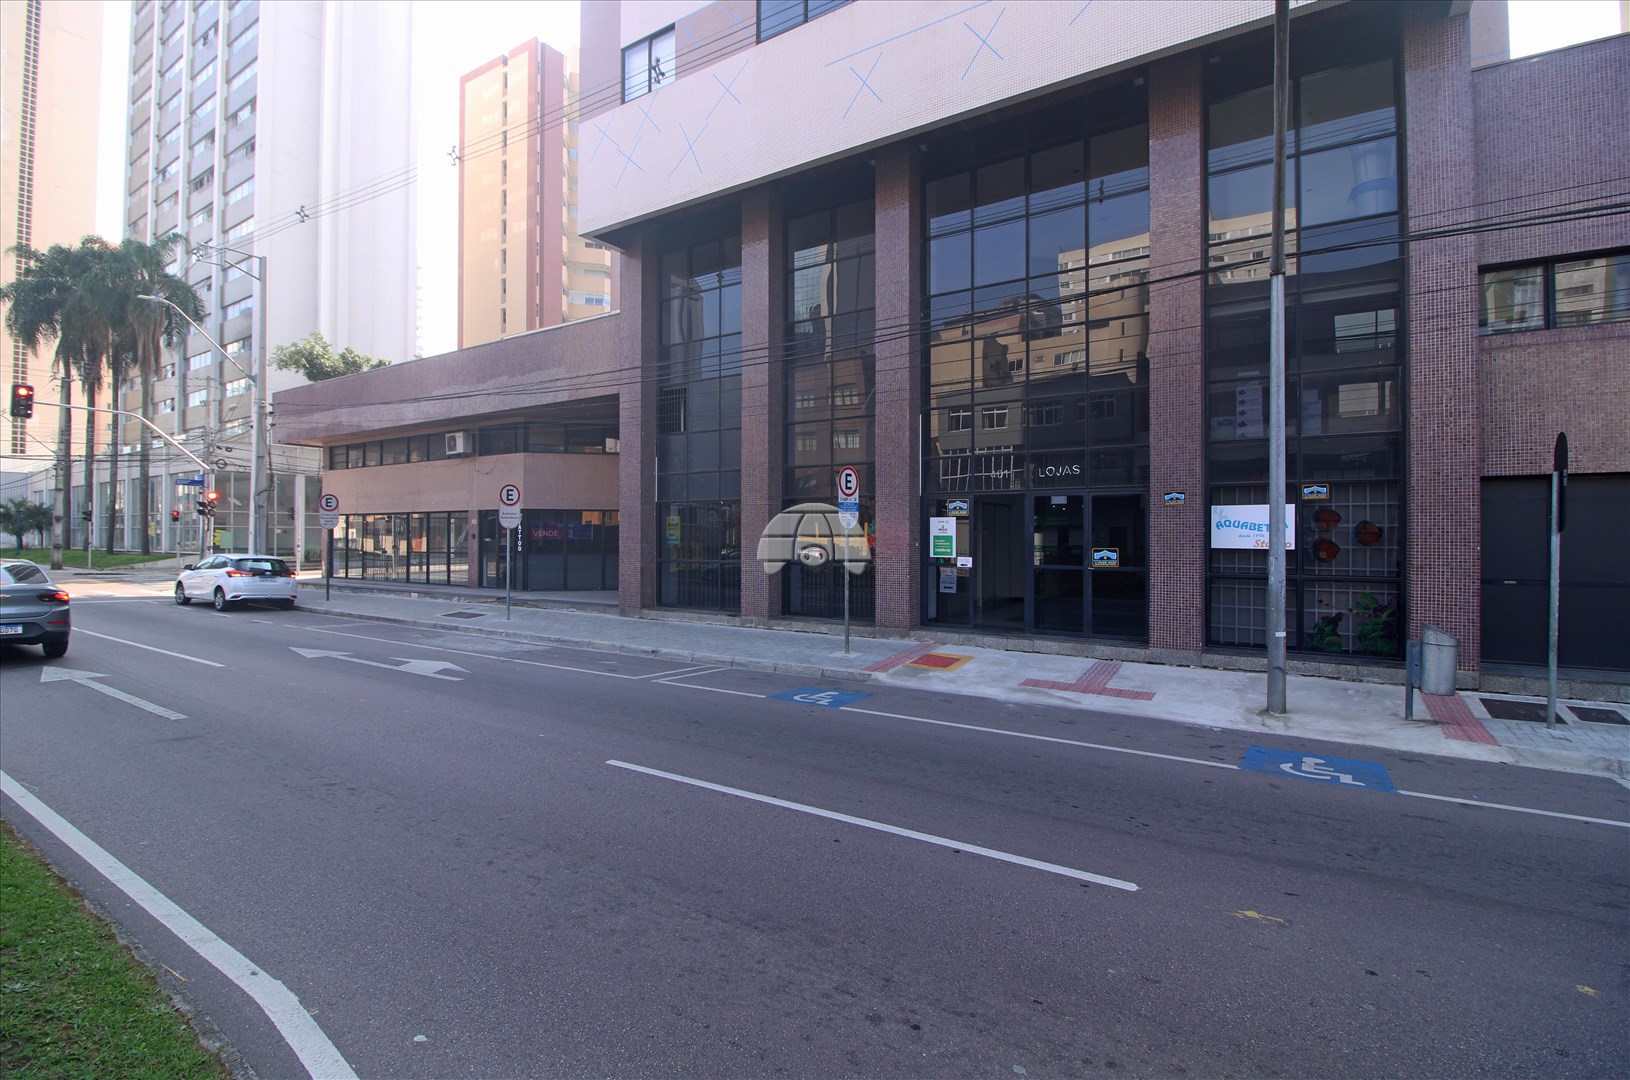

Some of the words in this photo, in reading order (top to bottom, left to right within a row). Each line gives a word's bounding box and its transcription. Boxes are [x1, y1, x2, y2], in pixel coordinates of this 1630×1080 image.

[1038, 464, 1080, 478] LOJAS
[845, 473, 853, 490] E
[506, 488, 514, 501] E
[325, 497, 333, 508] E
